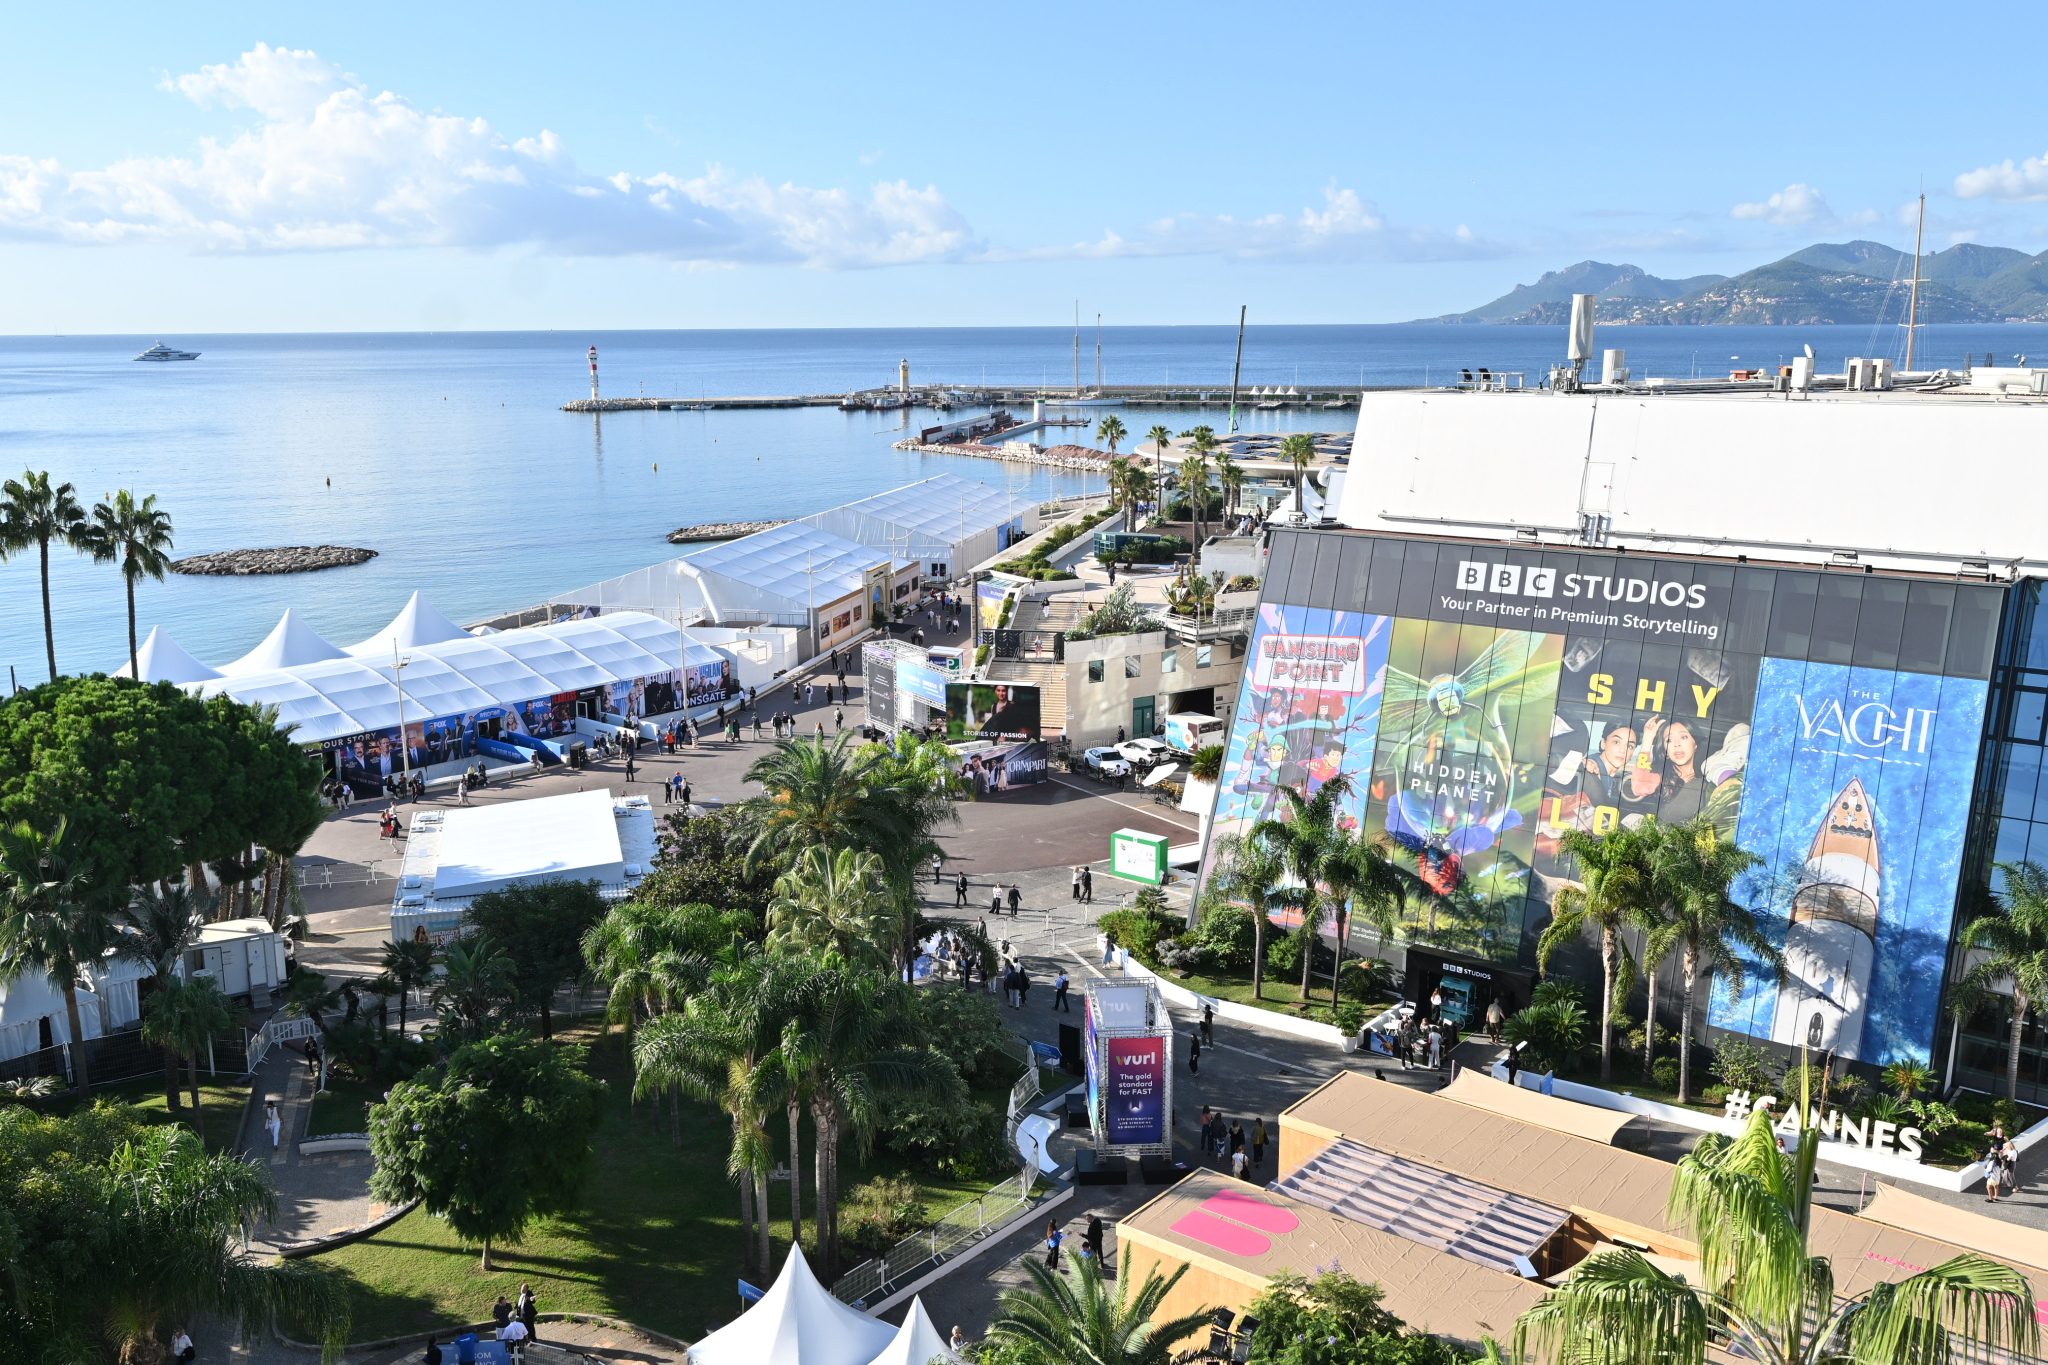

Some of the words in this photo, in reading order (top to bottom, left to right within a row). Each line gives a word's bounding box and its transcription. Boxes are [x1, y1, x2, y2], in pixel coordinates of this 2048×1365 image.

[1456, 561, 1556, 598] BBC
[1563, 574, 1706, 608] STUDIOS
[1441, 596, 1473, 612] Your
[1475, 600, 1530, 617] Partner
[1534, 605, 1546, 619] in
[1551, 607, 1618, 627] Premium
[1622, 614, 1719, 640] Storytelling
[1263, 639, 1361, 662] VANISHING
[946, 659, 955, 670] P
[1273, 661, 1344, 682] POINT
[644, 672, 670, 688] DEFIANT
[1587, 673, 1721, 718] SHY
[1852, 690, 1880, 700] THE
[532, 701, 544, 709] FOX
[434, 720, 447, 729] FOX
[1794, 694, 1938, 753] YACHT
[347, 732, 378, 745] STORY
[1006, 759, 1027, 773] TORN
[1637, 753, 1652, 770] &
[1413, 761, 1497, 786] HIDDEN
[1411, 778, 1494, 804] PLANET
[1442, 963, 1463, 974] BBC
[1463, 968, 1492, 980] STUDIOS
[1116, 1051, 1156, 1066] wurl
[1118, 1080, 1153, 1088] standard
[1135, 1072, 1152, 1081] gold
[1119, 1088, 1131, 1096] for
